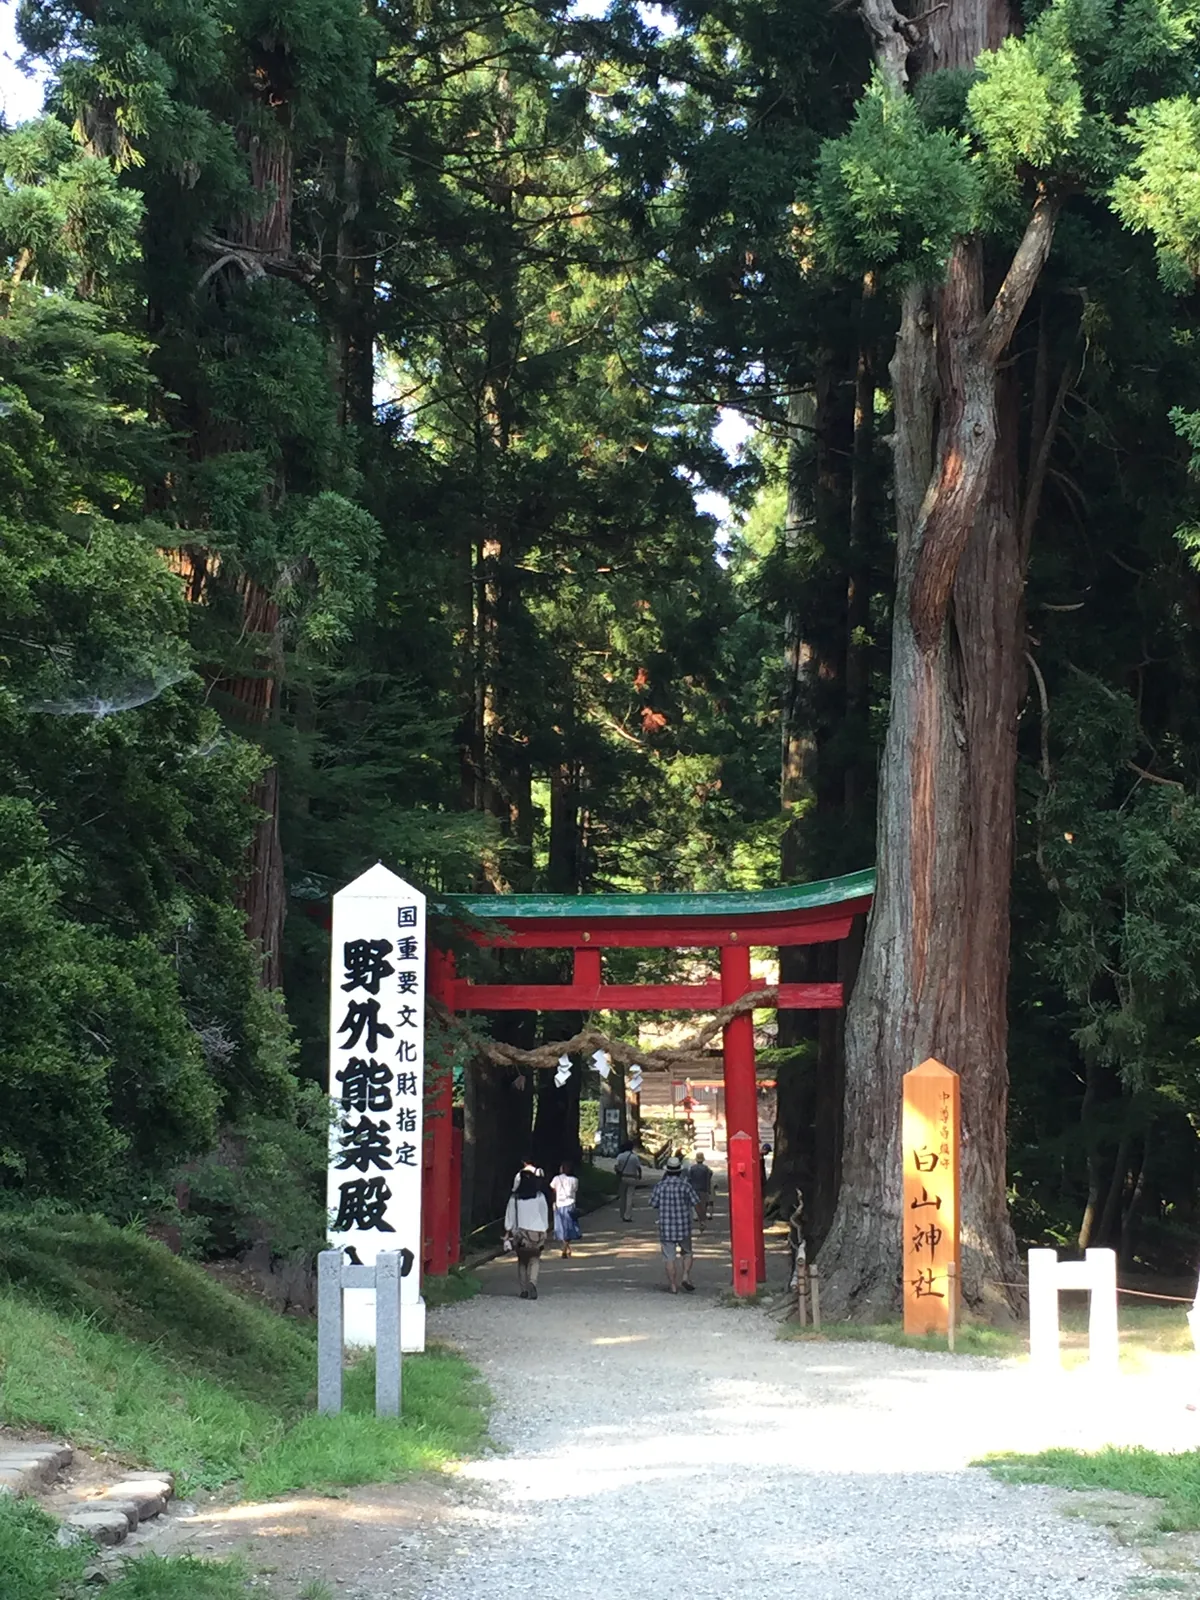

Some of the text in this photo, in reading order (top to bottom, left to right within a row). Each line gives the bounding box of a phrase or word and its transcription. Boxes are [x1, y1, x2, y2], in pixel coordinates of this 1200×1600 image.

[333, 938, 396, 1234] 野外能楽殿
[396, 905, 418, 1167] 国重要文化財指定
[910, 1145, 945, 1298] 白山神社
